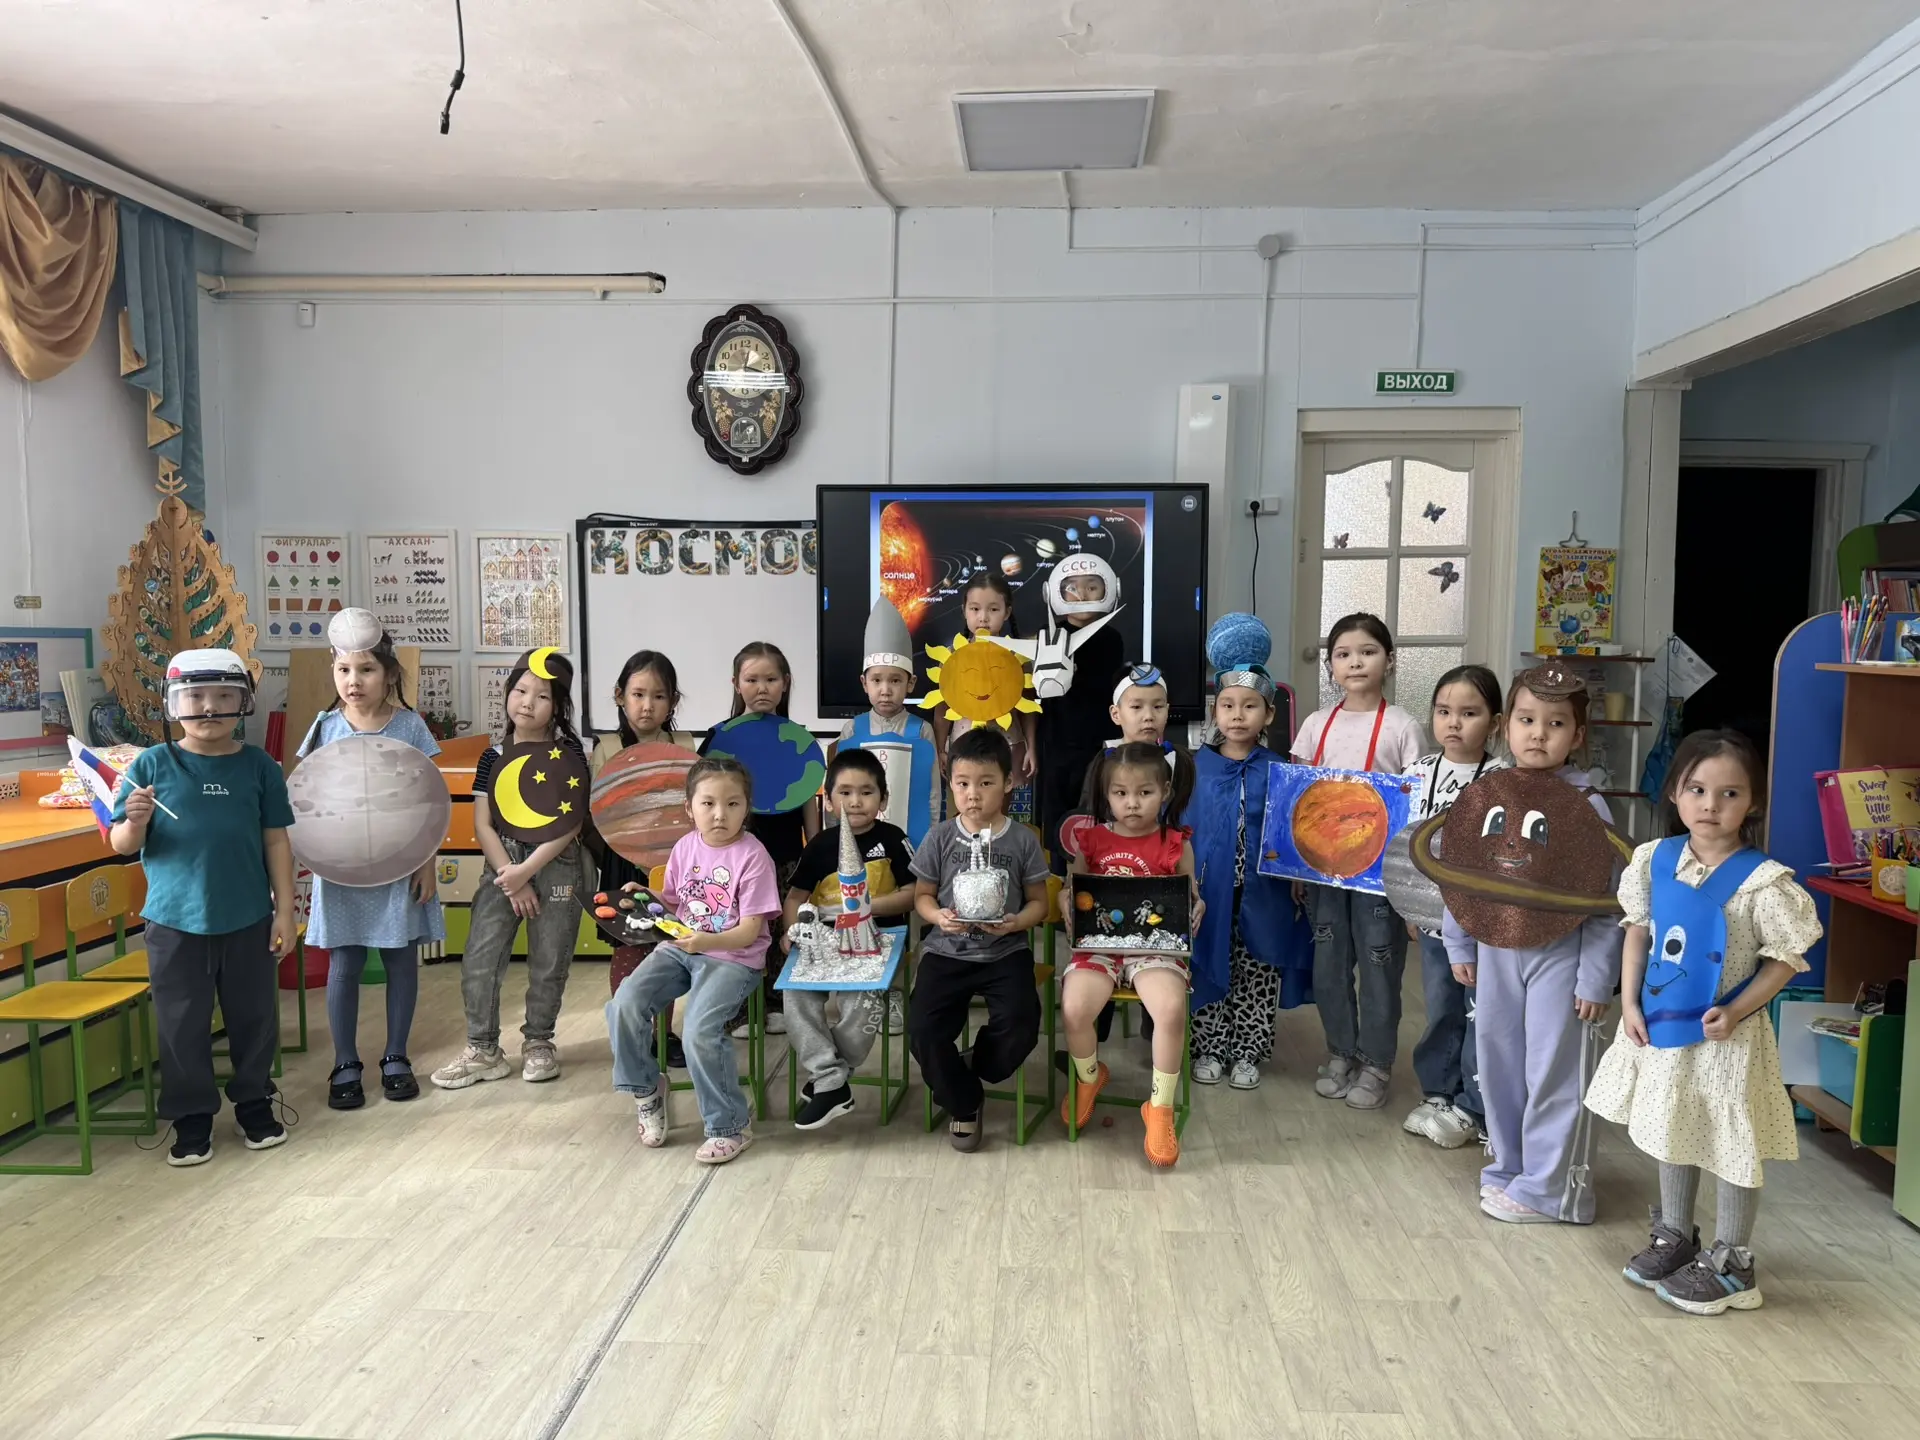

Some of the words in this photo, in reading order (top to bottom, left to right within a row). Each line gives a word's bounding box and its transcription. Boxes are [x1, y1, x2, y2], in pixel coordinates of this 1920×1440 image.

[730, 343, 737, 351] 11
[740, 340, 751, 348] 12
[755, 344, 759, 352] 1
[722, 352, 731, 360] 10
[761, 352, 770, 360] 2
[719, 363, 727, 371] 9
[763, 363, 771, 371] 3
[1384, 374, 1448, 390] ВЫХОД
[275, 539, 332, 547] ФИГУРАЛАР
[388, 538, 431, 546] АХСААН
[1061, 561, 1097, 573] СССР
[883, 571, 916, 580] солнце
[866, 653, 899, 666] СССР
[1858, 780, 1888, 793] Sweet
[1870, 814, 1891, 824] one
